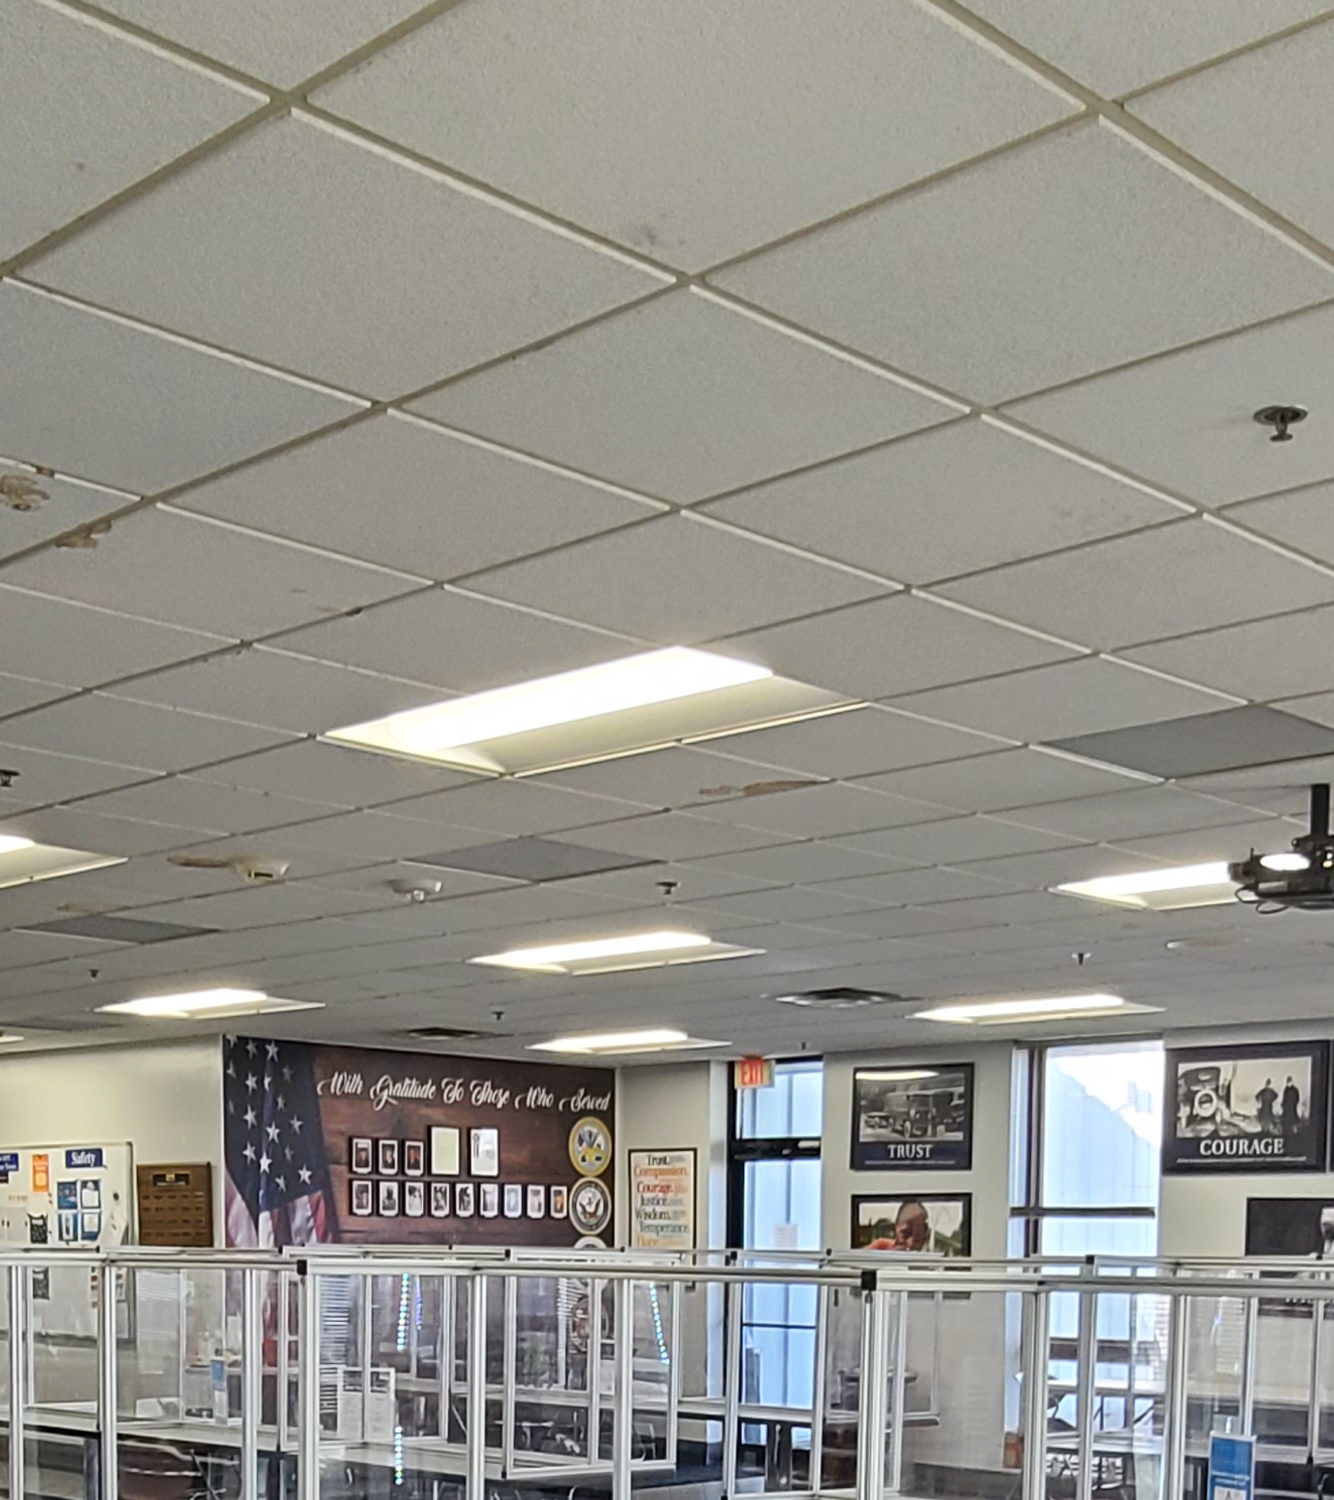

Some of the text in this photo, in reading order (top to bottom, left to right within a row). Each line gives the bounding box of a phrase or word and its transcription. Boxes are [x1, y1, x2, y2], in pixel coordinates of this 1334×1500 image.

[741, 1062, 764, 1086] EXIT
[317, 1071, 611, 1112] With Gratitude To Those Who Served
[887, 1144, 934, 1159] TRUST
[1199, 1138, 1284, 1156] COURAGE
[71, 1151, 96, 1167] Safety
